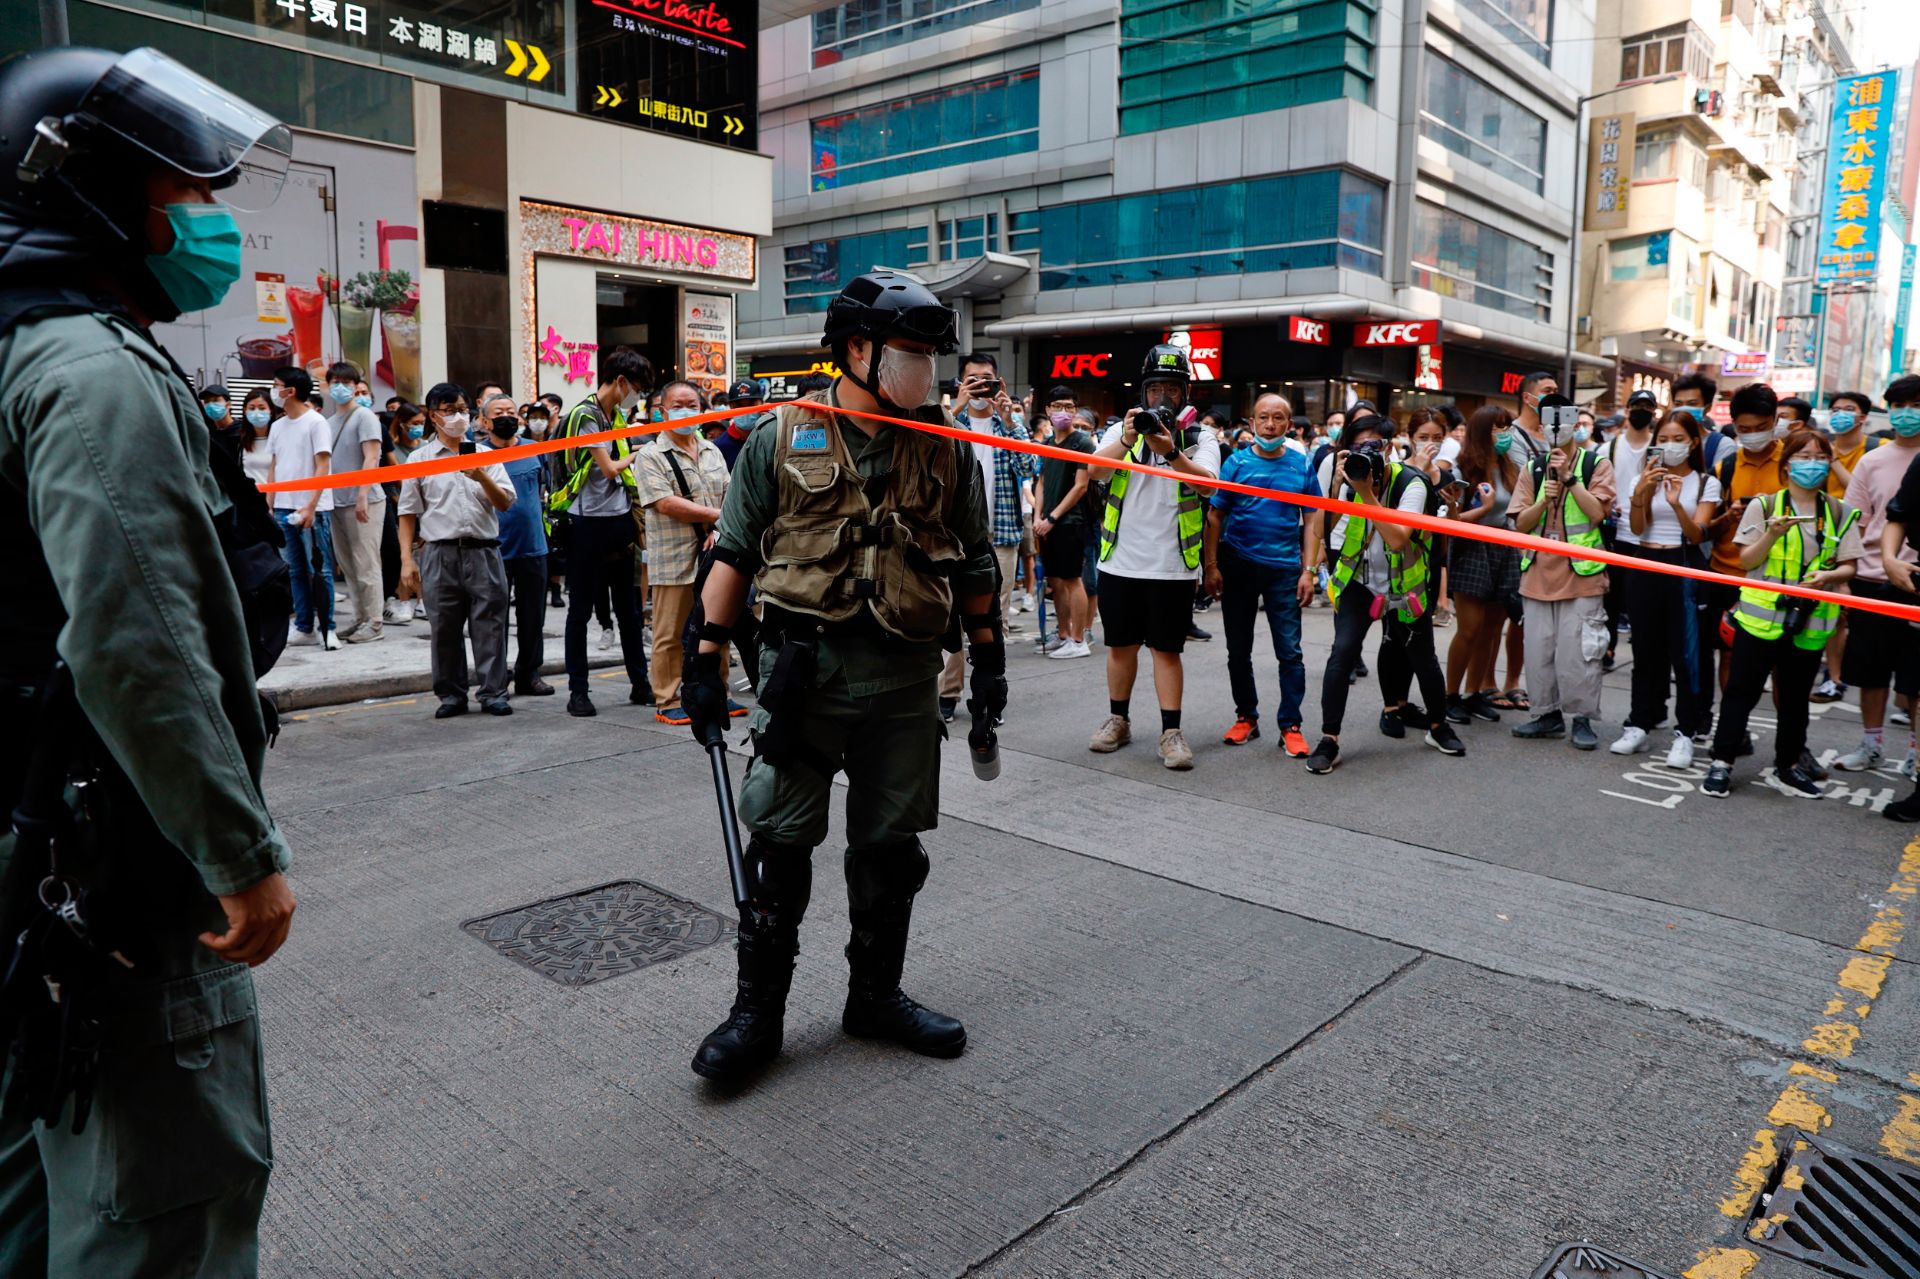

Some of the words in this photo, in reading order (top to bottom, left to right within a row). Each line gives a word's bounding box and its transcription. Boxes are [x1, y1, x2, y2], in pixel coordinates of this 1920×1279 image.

[639, 98, 707, 128] 山東街入口
[1832, 77, 1884, 249] 浦東水療桑拿
[563, 217, 621, 254] TAI
[638, 227, 718, 268] HING
[1296, 320, 1323, 343] KFC
[1366, 323, 1422, 344] KFC
[1051, 353, 1110, 378] KFC
[1192, 348, 1218, 359] KFC
[1502, 372, 1525, 394] KF
